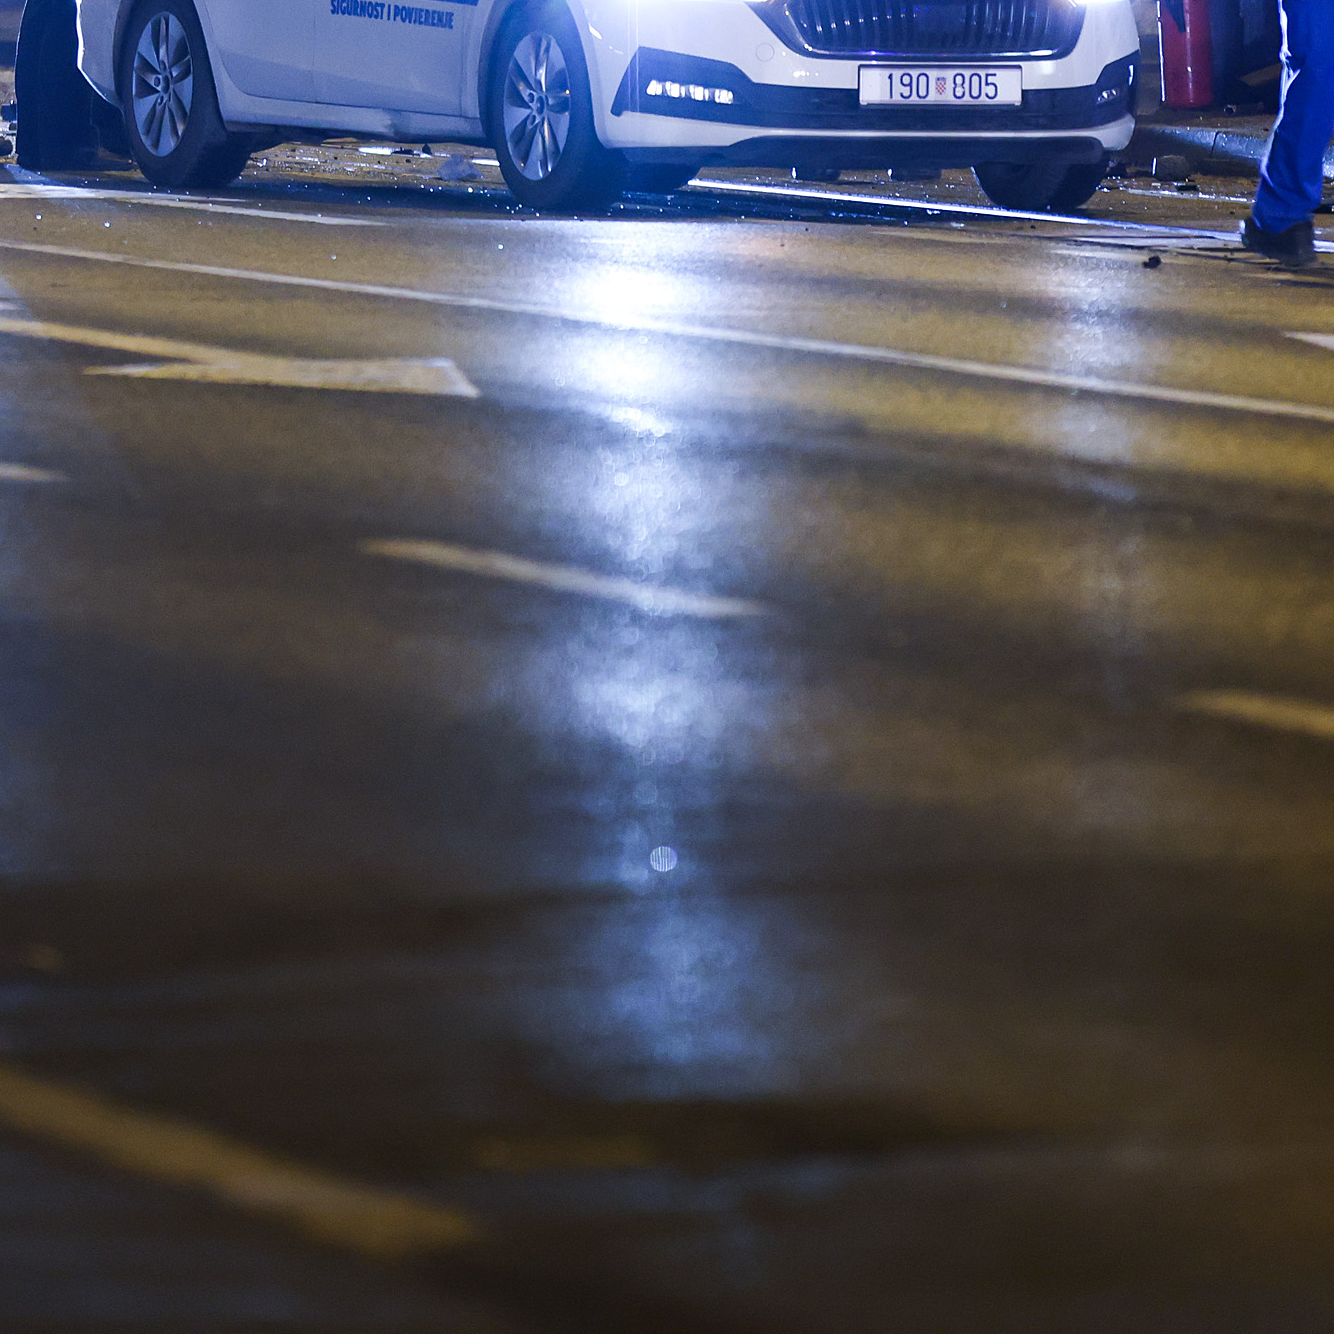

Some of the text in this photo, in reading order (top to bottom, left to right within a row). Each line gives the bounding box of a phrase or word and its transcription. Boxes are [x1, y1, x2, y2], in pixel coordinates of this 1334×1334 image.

[386, 4, 391, 21] I
[393, 4, 454, 29] POVJERENJE
[887, 72, 998, 100] 190 805
